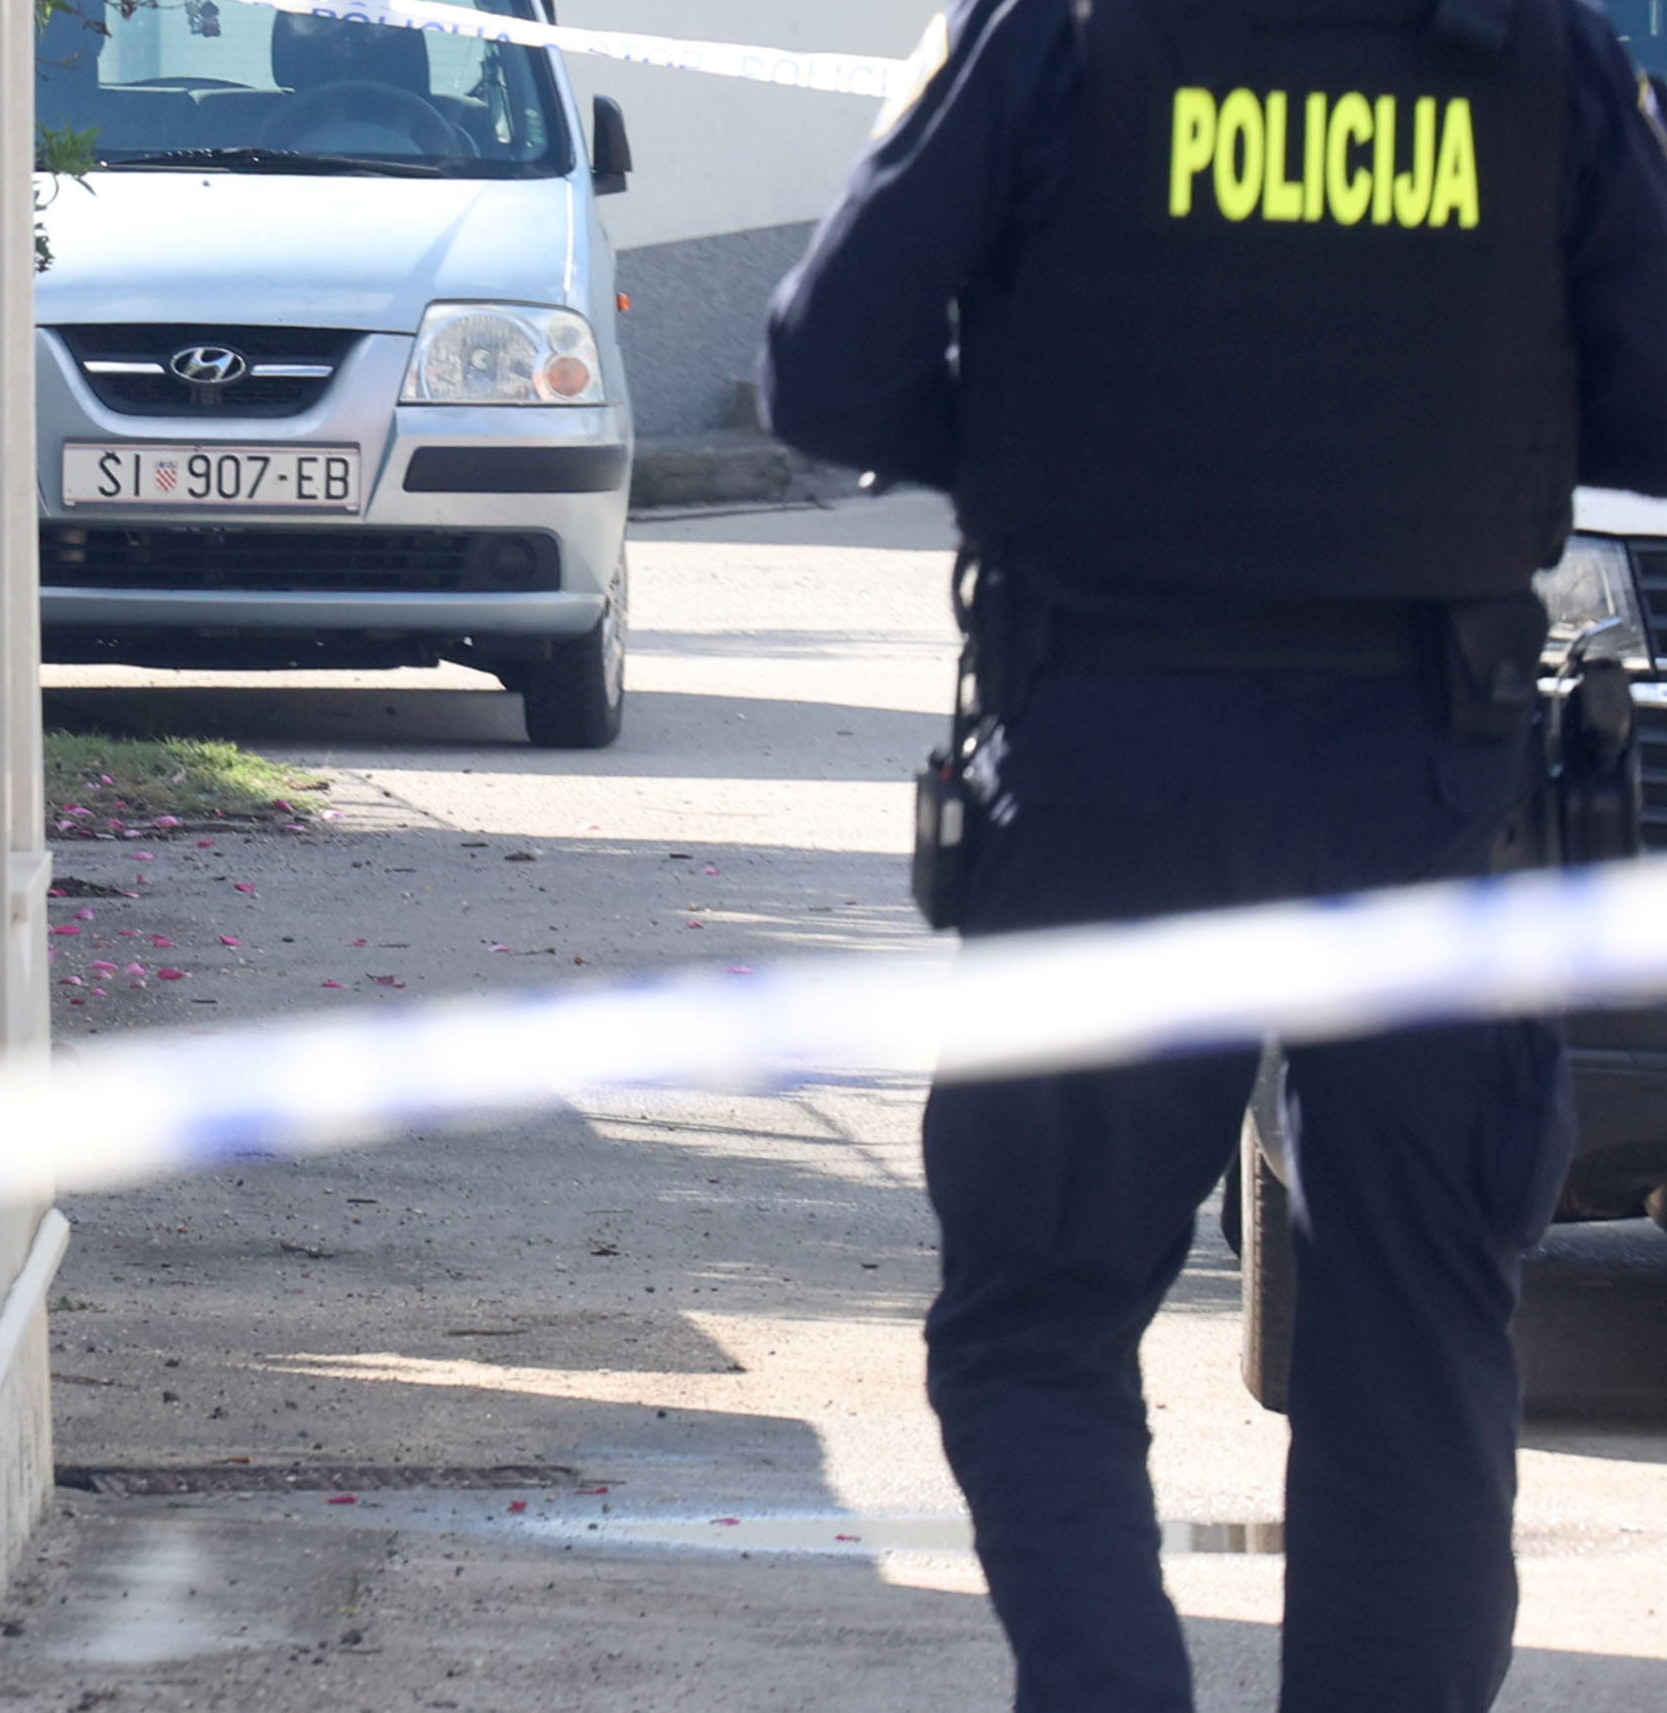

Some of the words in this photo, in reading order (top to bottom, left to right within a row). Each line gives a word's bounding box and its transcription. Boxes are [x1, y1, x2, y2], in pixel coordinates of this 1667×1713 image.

[1169, 86, 1480, 229] POLICIJA
[97, 450, 142, 498] ŠI
[186, 453, 351, 501] 907-EB
